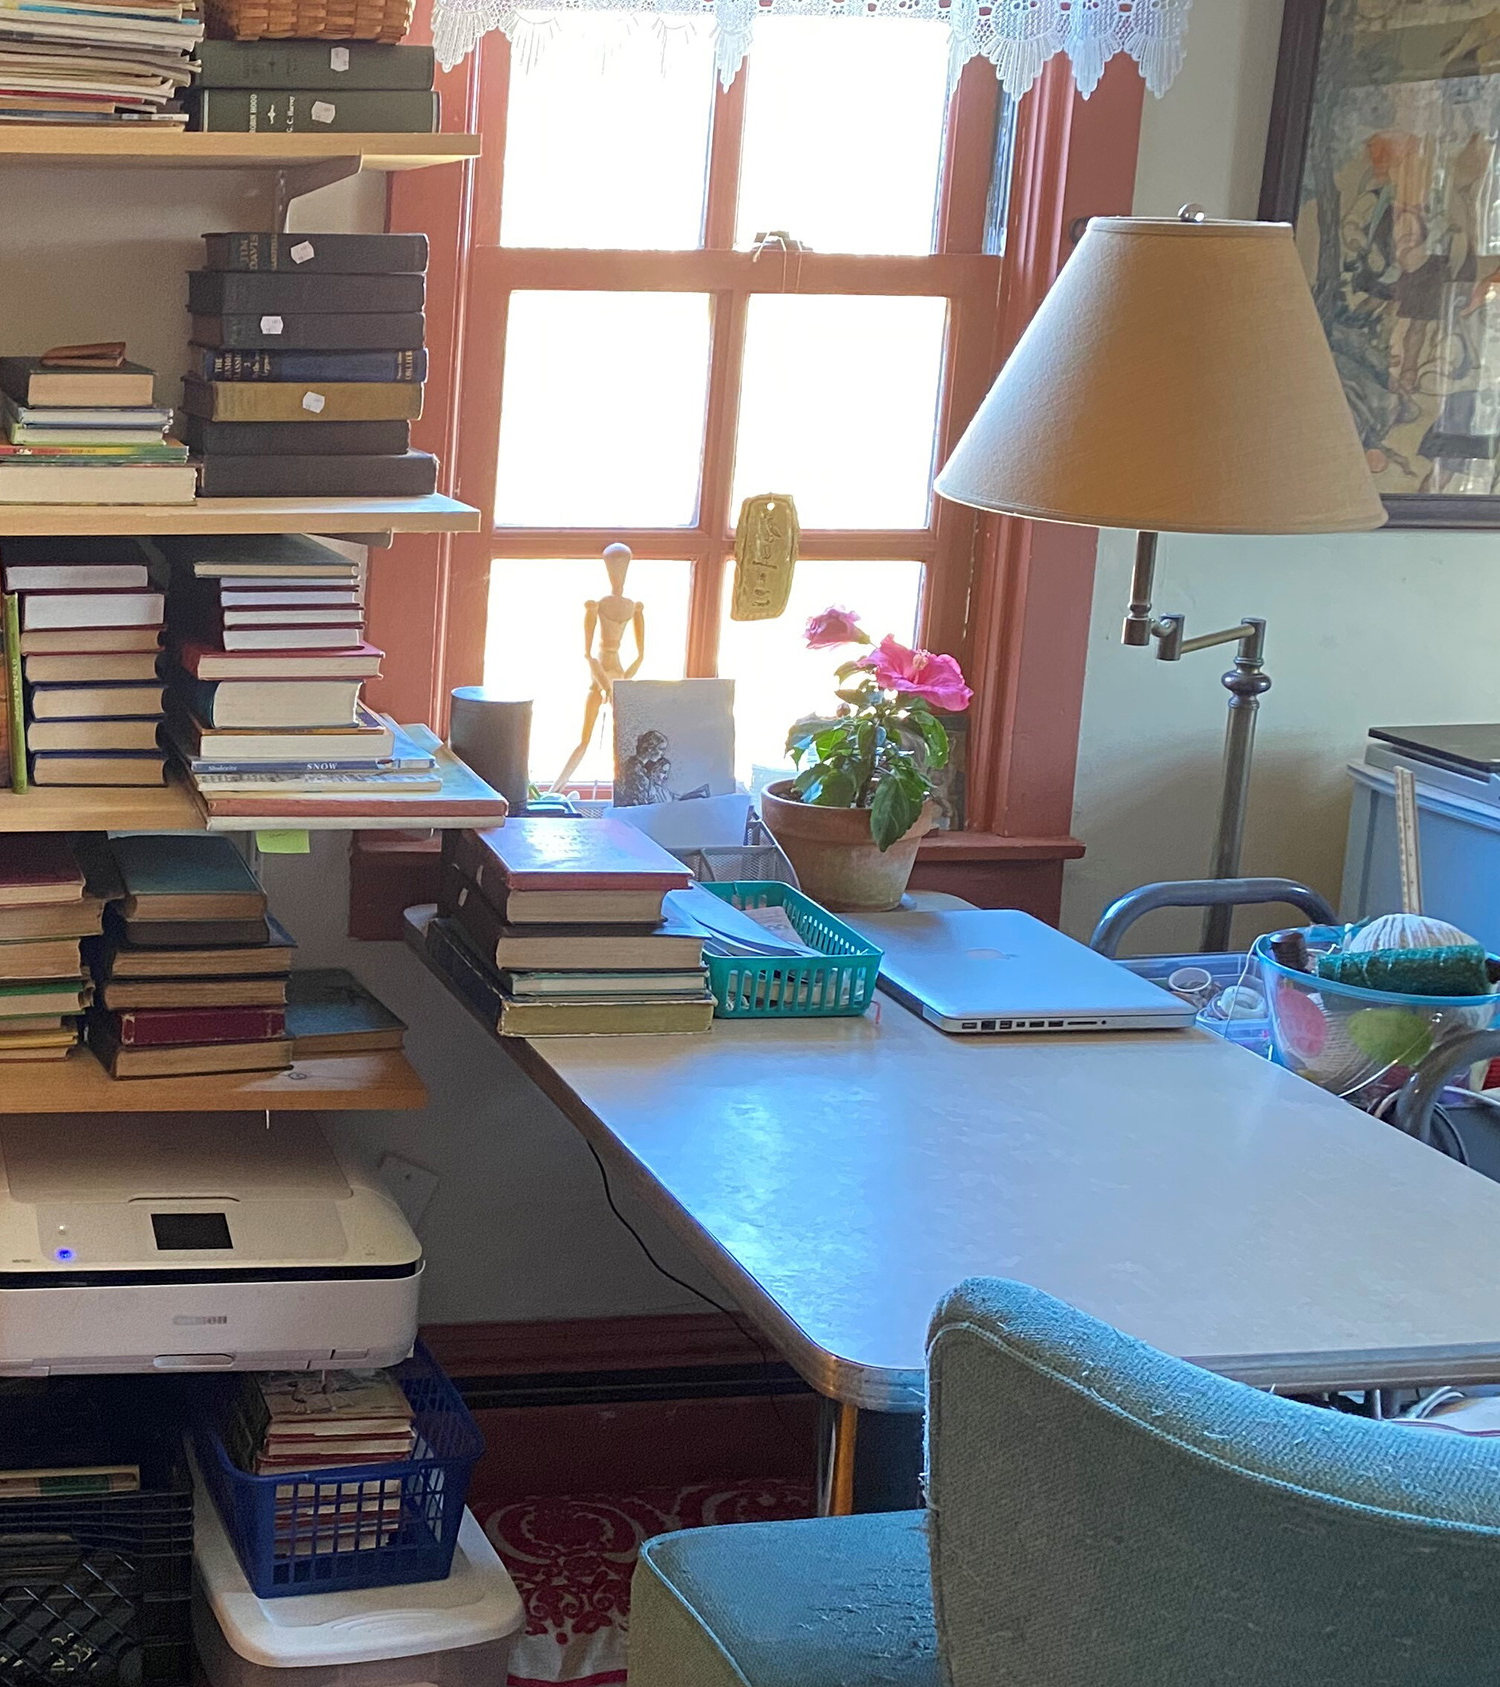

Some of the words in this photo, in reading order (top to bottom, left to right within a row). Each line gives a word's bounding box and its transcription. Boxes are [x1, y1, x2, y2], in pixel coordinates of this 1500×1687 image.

[249, 93, 258, 113] HOOD
[240, 240, 249, 262] JIM
[249, 234, 259, 271] DAVIS
[214, 357, 223, 373] THE
[306, 762, 338, 771] SNOW
